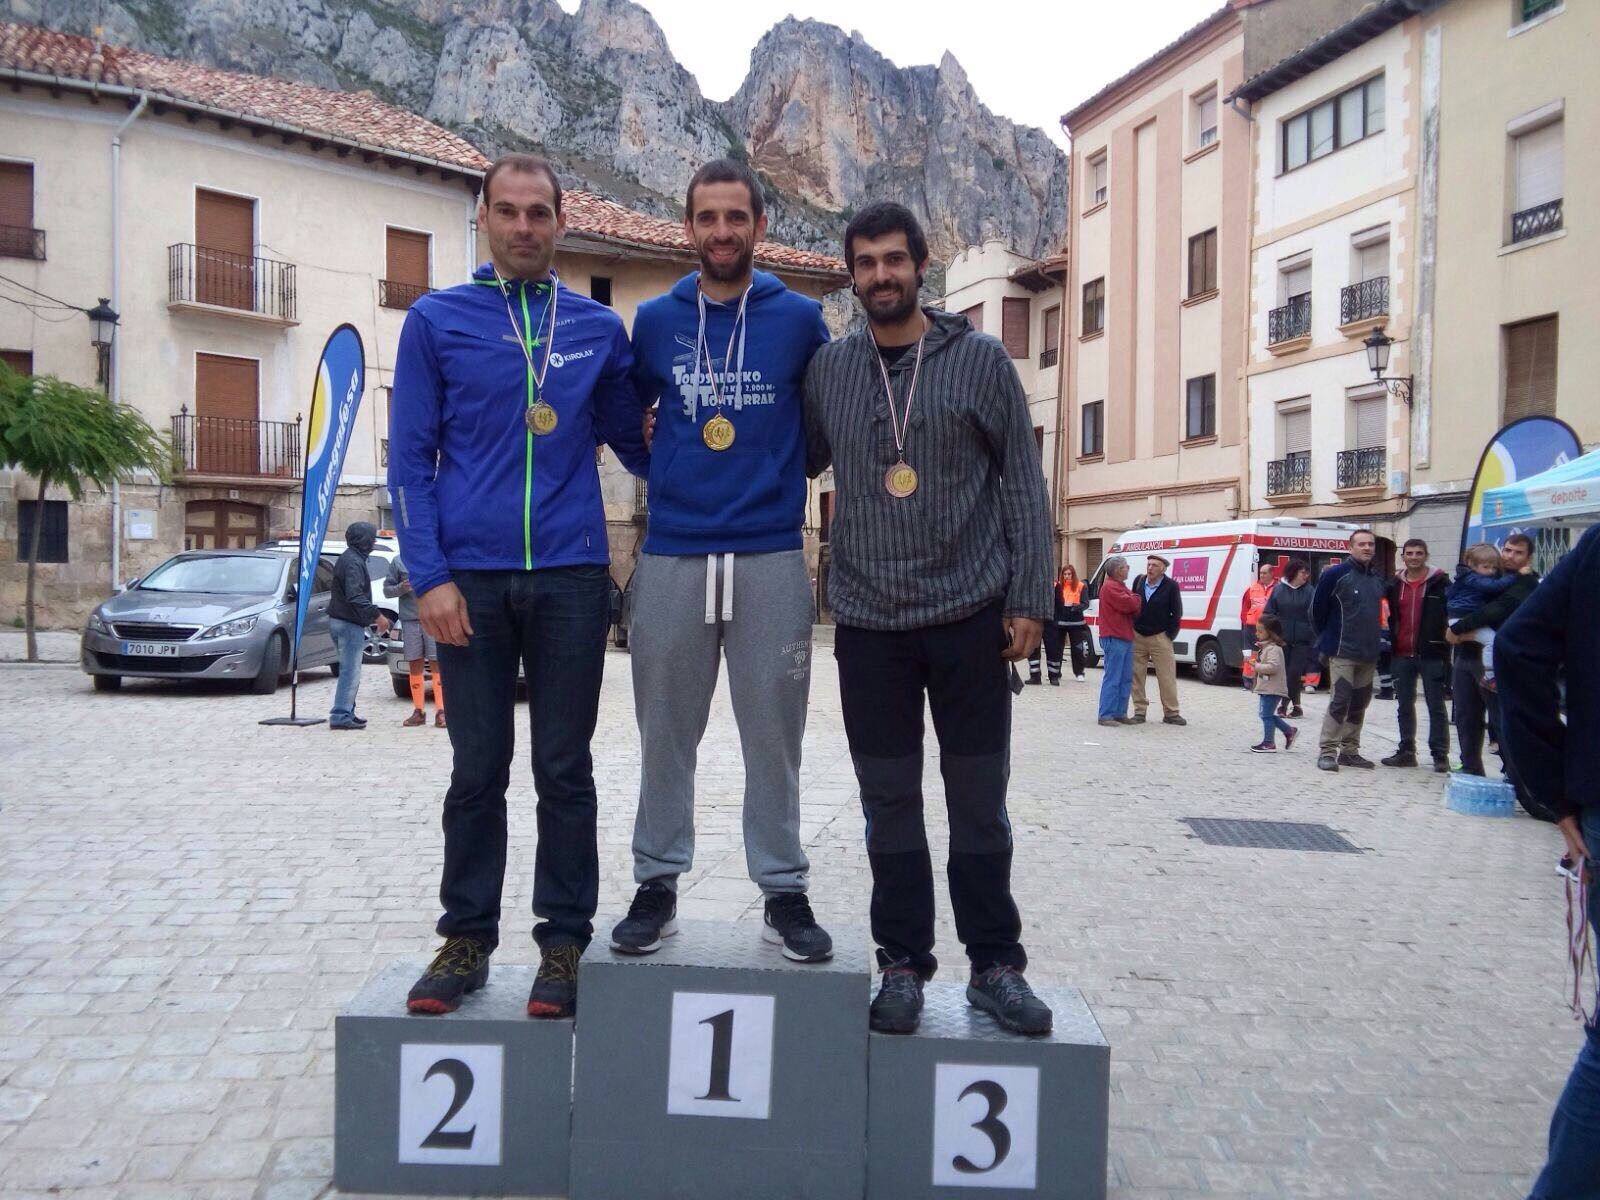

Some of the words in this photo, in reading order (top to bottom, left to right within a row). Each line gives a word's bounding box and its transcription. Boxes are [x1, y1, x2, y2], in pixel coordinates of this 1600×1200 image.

[563, 349, 595, 363] KIROLAK
[699, 385, 776, 406] TONTRRAK
[1551, 488, 1587, 505] deporte
[1126, 541, 1164, 552] AMBULANCIA
[1273, 536, 1347, 550] AMBULANCIA
[129, 644, 154, 655] 7010
[694, 1008, 741, 1103] 1
[418, 1058, 476, 1150] 2
[952, 1080, 1012, 1175] 3
